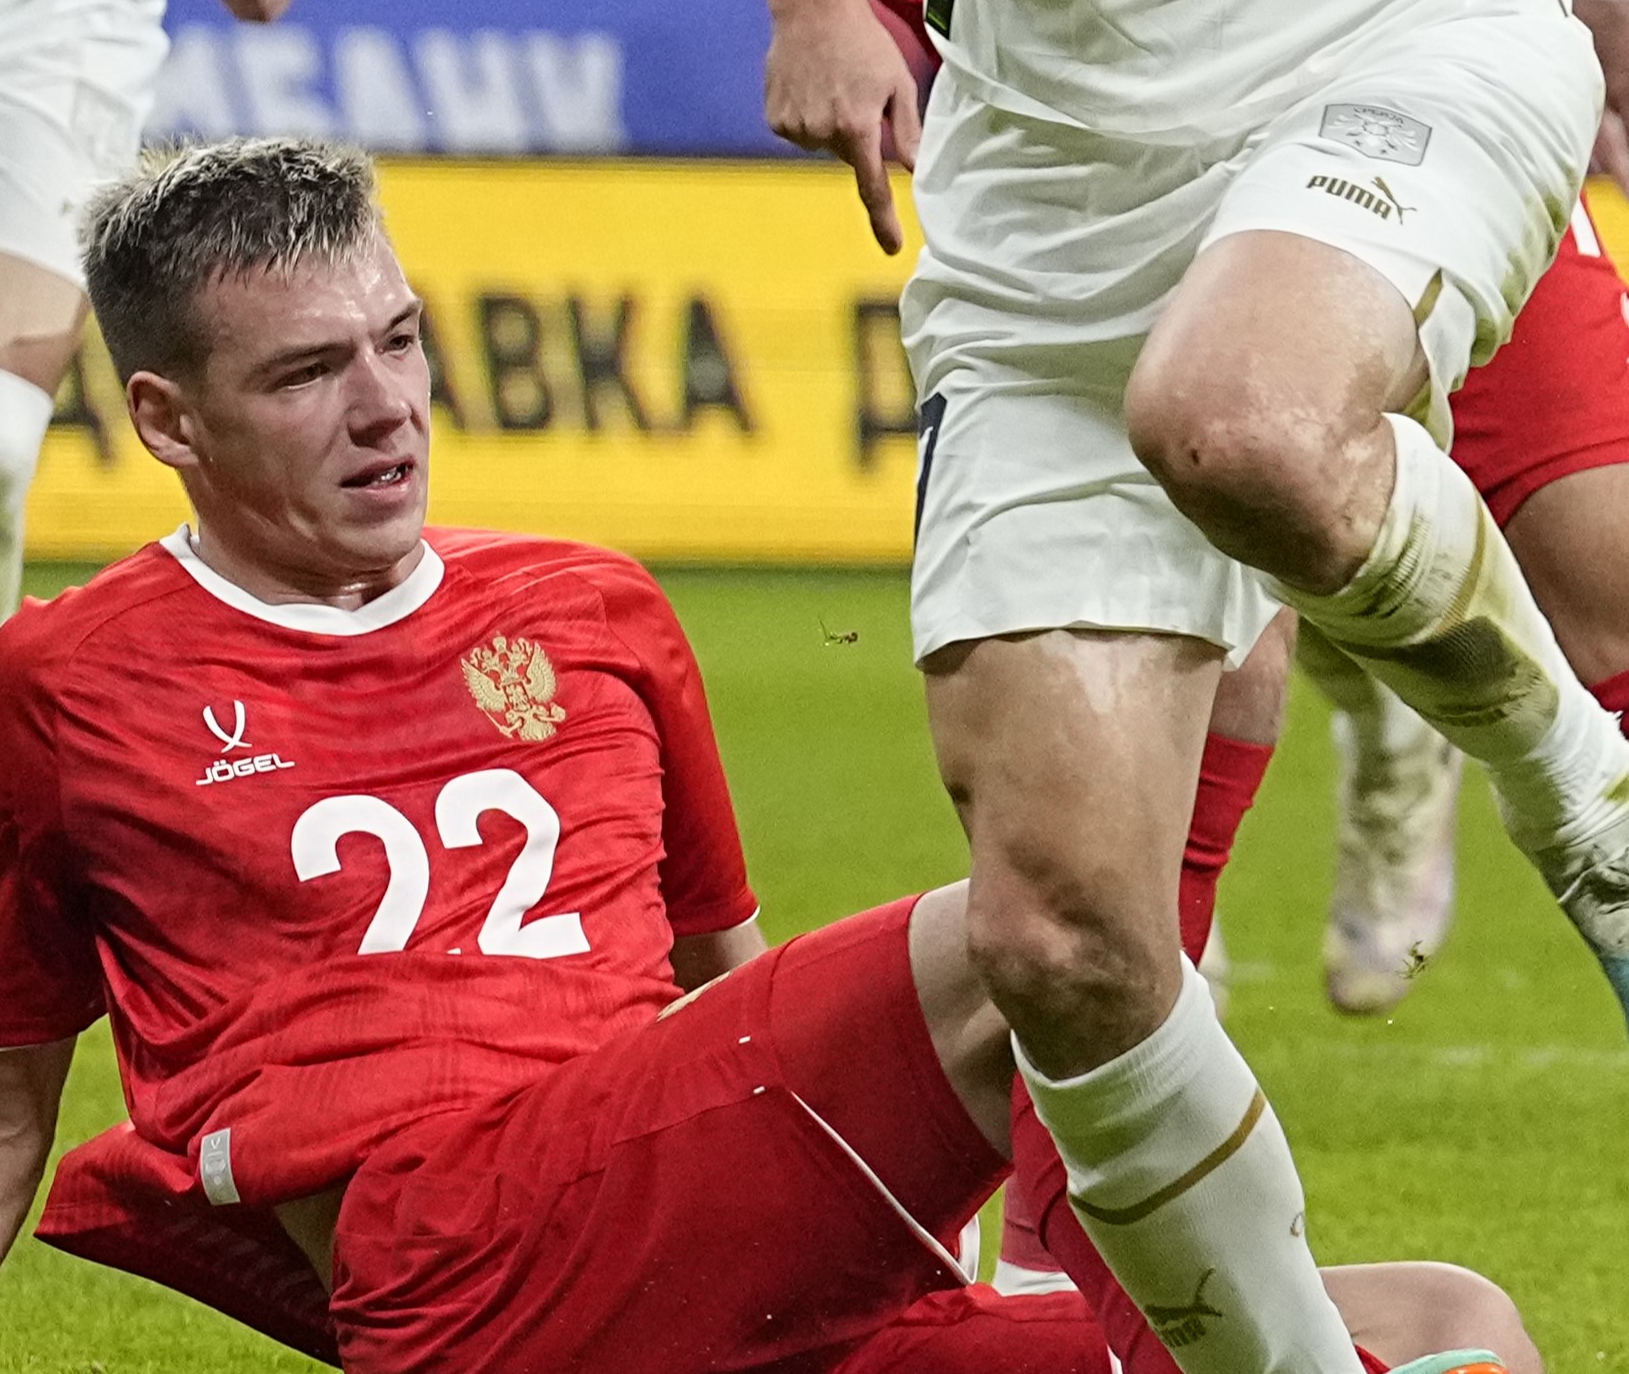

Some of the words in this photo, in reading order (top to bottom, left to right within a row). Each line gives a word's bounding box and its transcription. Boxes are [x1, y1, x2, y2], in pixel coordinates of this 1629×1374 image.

[1306, 175, 1392, 220] PUMA
[195, 753, 296, 786] JÖGEL
[290, 768, 591, 959] 22
